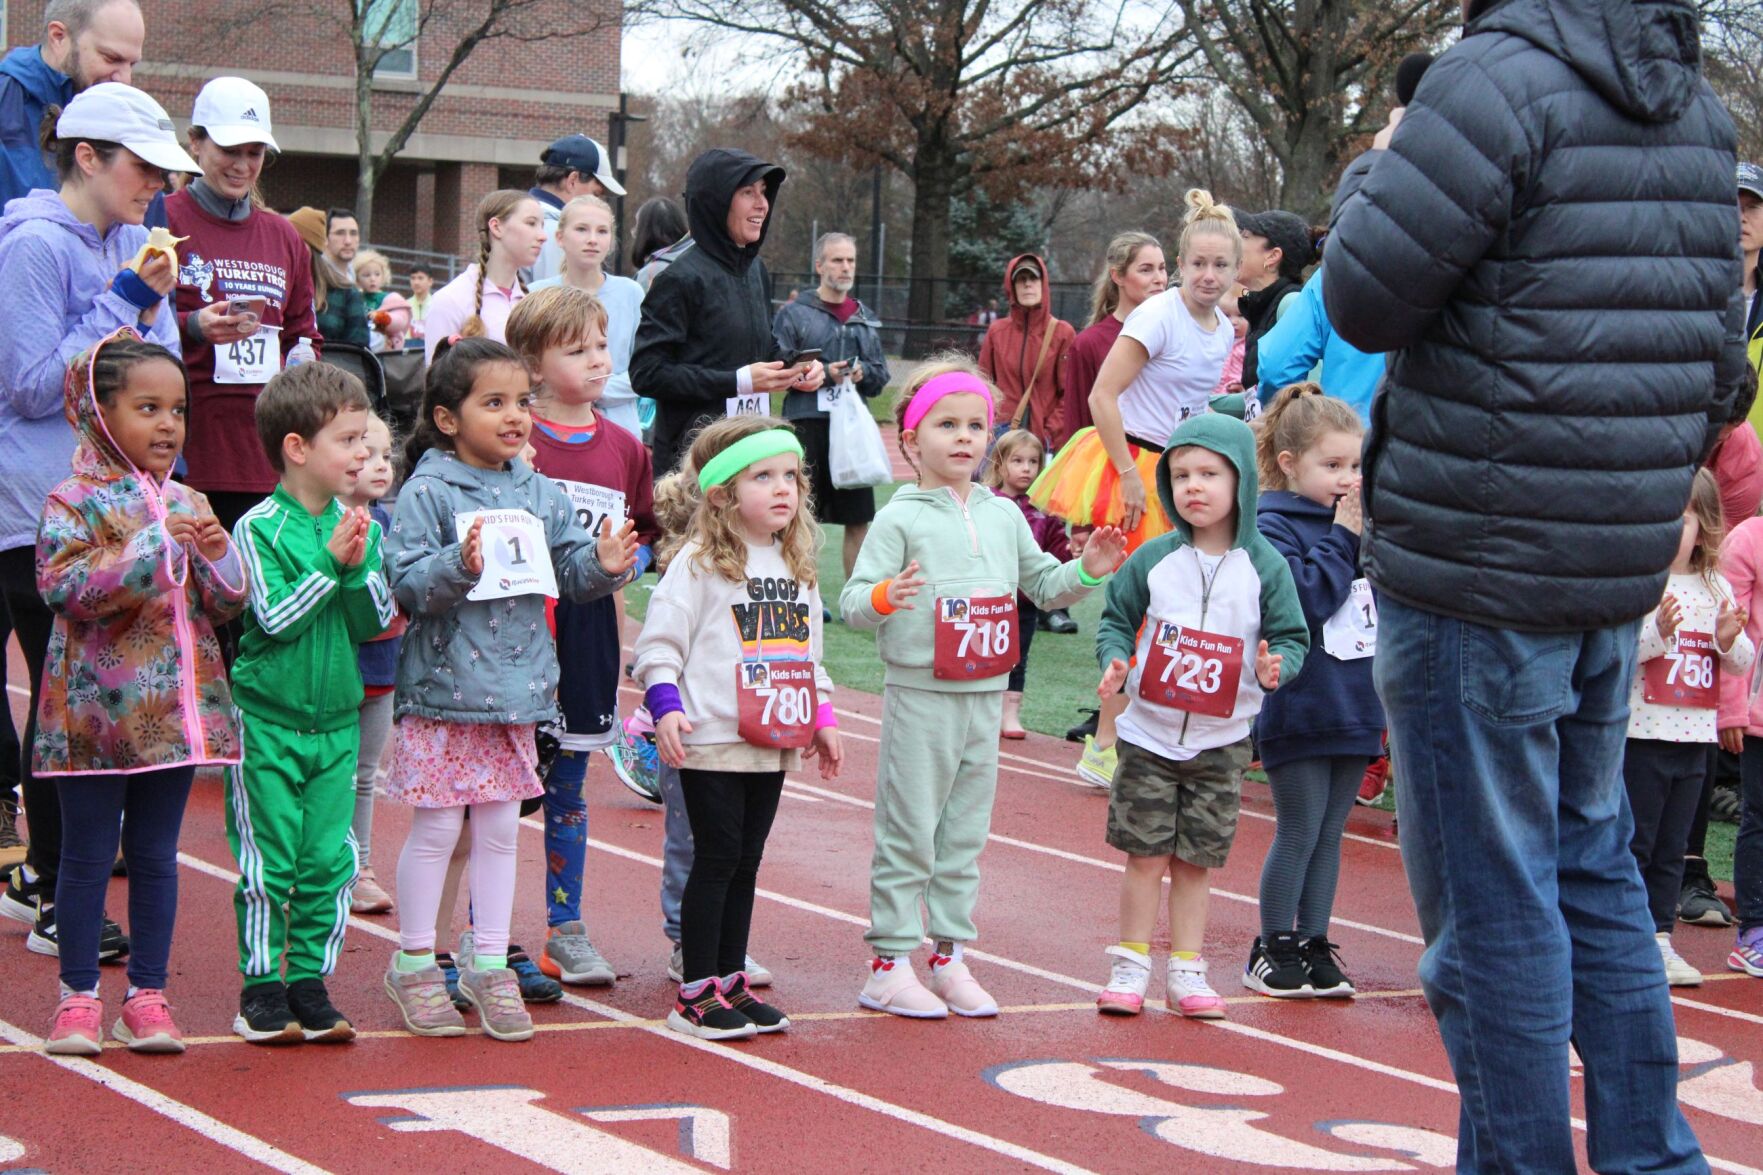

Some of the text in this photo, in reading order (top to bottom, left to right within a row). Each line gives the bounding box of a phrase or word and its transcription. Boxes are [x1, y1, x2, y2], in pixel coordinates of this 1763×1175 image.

[215, 268, 265, 282] TURKEY
[224, 281, 234, 289] 10
[234, 283, 257, 292] YEARS
[229, 338, 267, 366] 437
[571, 494, 595, 507] Turkey
[574, 484, 614, 501] Westborough
[504, 513, 519, 524] FUN
[520, 514, 533, 525] RUN
[507, 536, 527, 565] 1
[746, 577, 800, 602] GOOD
[970, 605, 989, 616] Kids
[991, 604, 1004, 614] Fun
[1004, 602, 1014, 612] Run
[1361, 603, 1375, 629] 1
[730, 601, 811, 643] VIBES
[954, 619, 1010, 658] 718
[1179, 635, 1198, 648] Kids
[1199, 640, 1216, 651] Fun
[1216, 643, 1233, 654] Run
[1679, 637, 1697, 648] Kids
[1697, 639, 1709, 649] Fun
[770, 668, 790, 680] Kids
[791, 669, 802, 680] Fun
[802, 669, 812, 680] Run
[1159, 648, 1223, 694] 723
[1663, 653, 1713, 689] 758
[755, 687, 812, 726] 780
